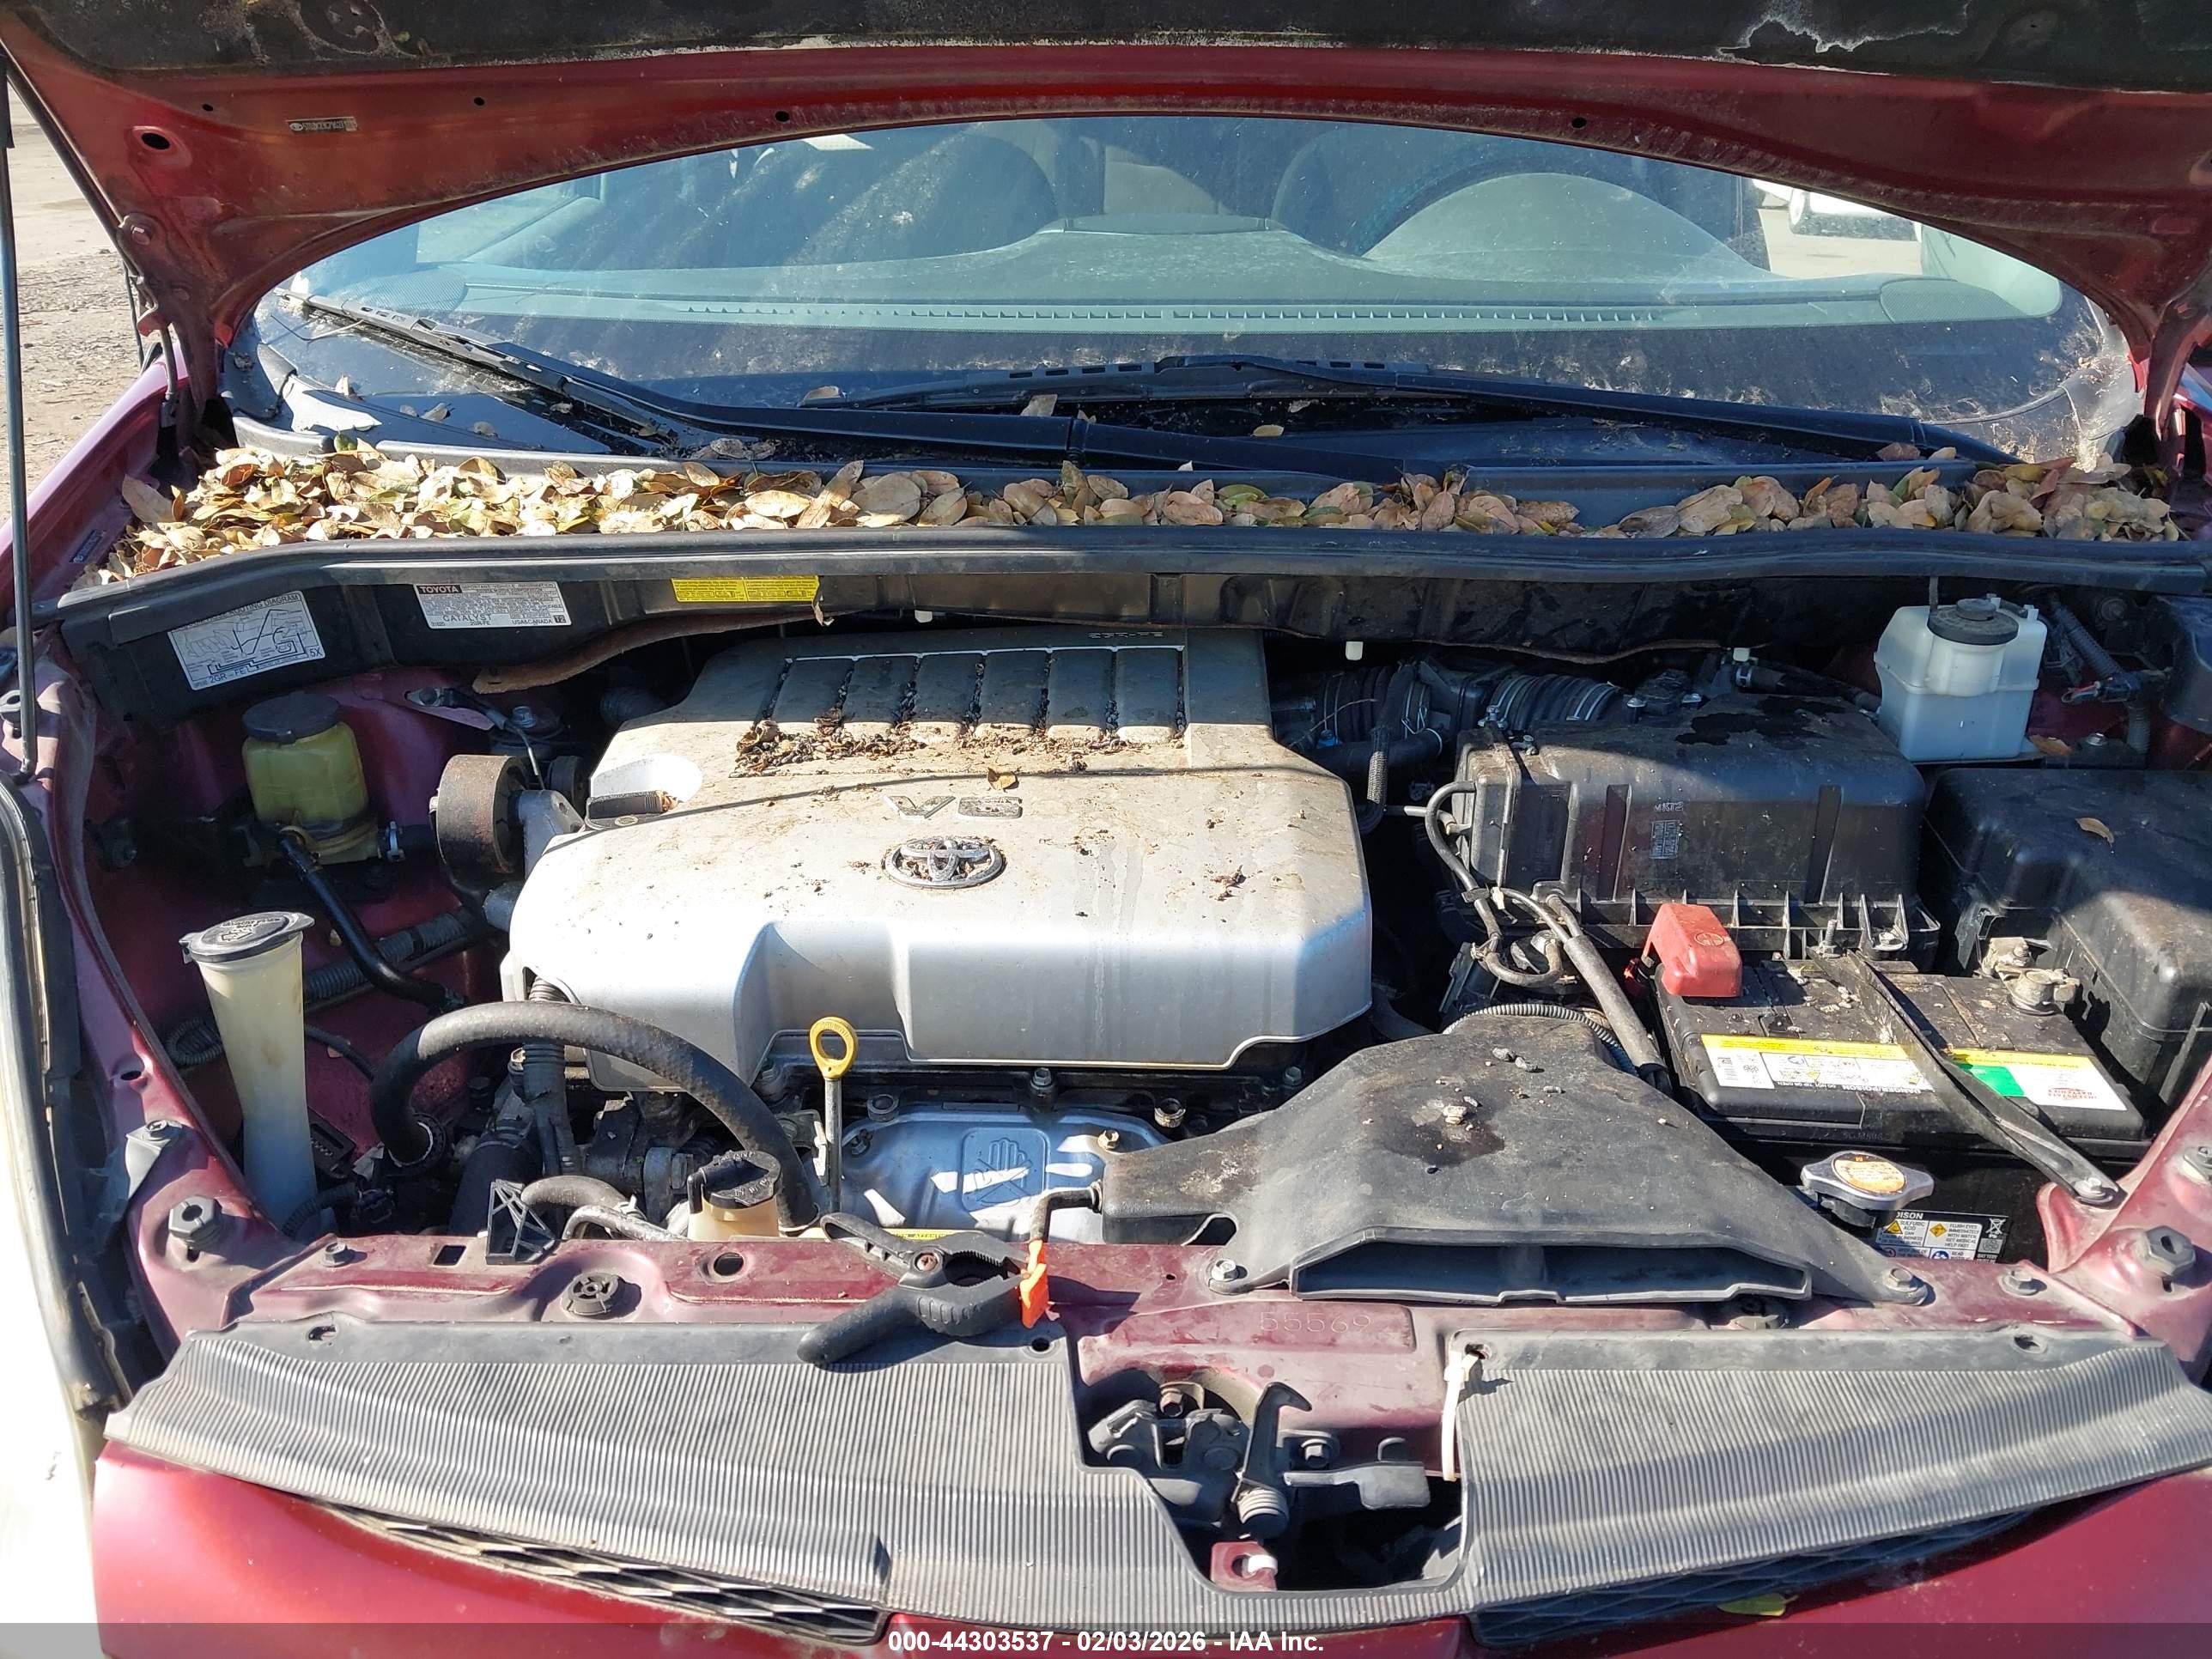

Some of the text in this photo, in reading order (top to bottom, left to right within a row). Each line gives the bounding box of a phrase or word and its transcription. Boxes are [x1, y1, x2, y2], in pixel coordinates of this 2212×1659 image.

[264, 594, 299, 607] DIAGRAM
[309, 648, 323, 658] 5X
[883, 795, 1024, 819] V6
[1260, 1311, 1371, 1334] 55569
